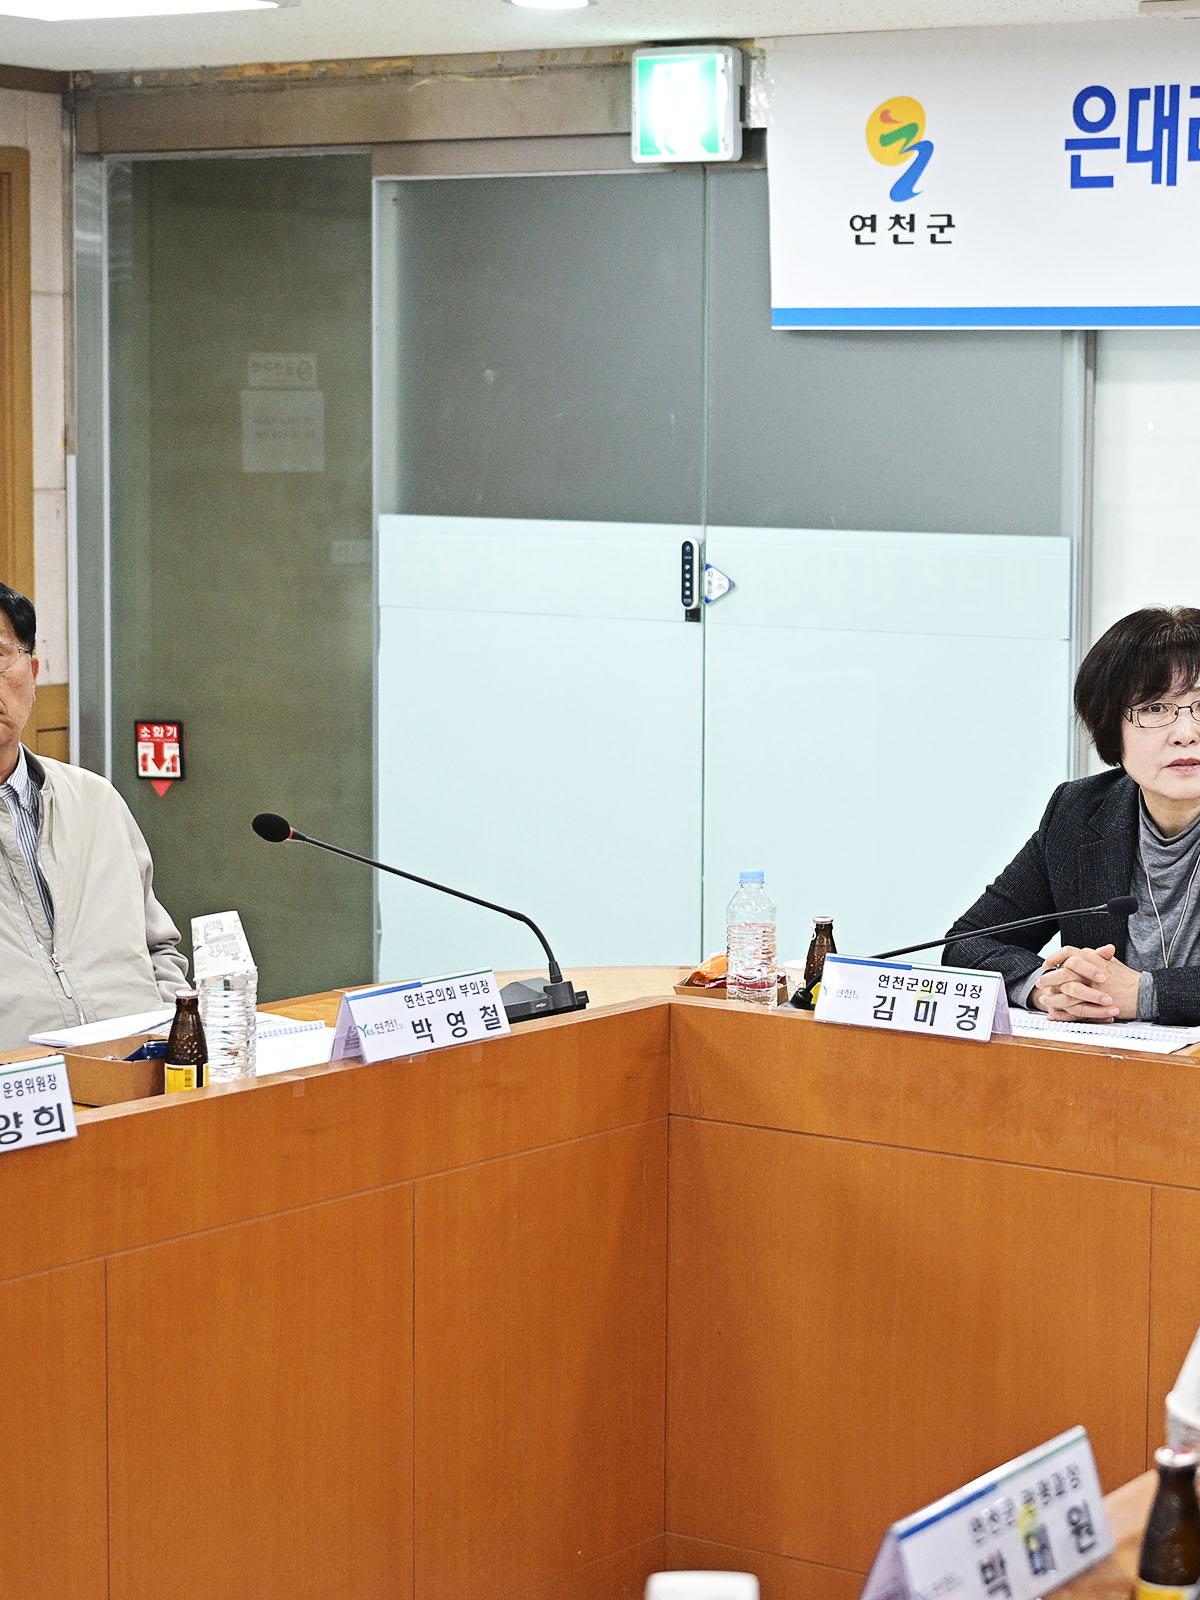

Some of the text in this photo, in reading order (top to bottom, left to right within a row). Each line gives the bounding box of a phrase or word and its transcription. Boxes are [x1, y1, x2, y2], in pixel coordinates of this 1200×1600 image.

[849, 213, 956, 246] 연천군
[140, 725, 177, 738] 소화기
[404, 979, 491, 1009] 연천군의회 부의장
[878, 974, 983, 999] 연천군의회 의장
[3, 1074, 57, 1098] 운영위원장
